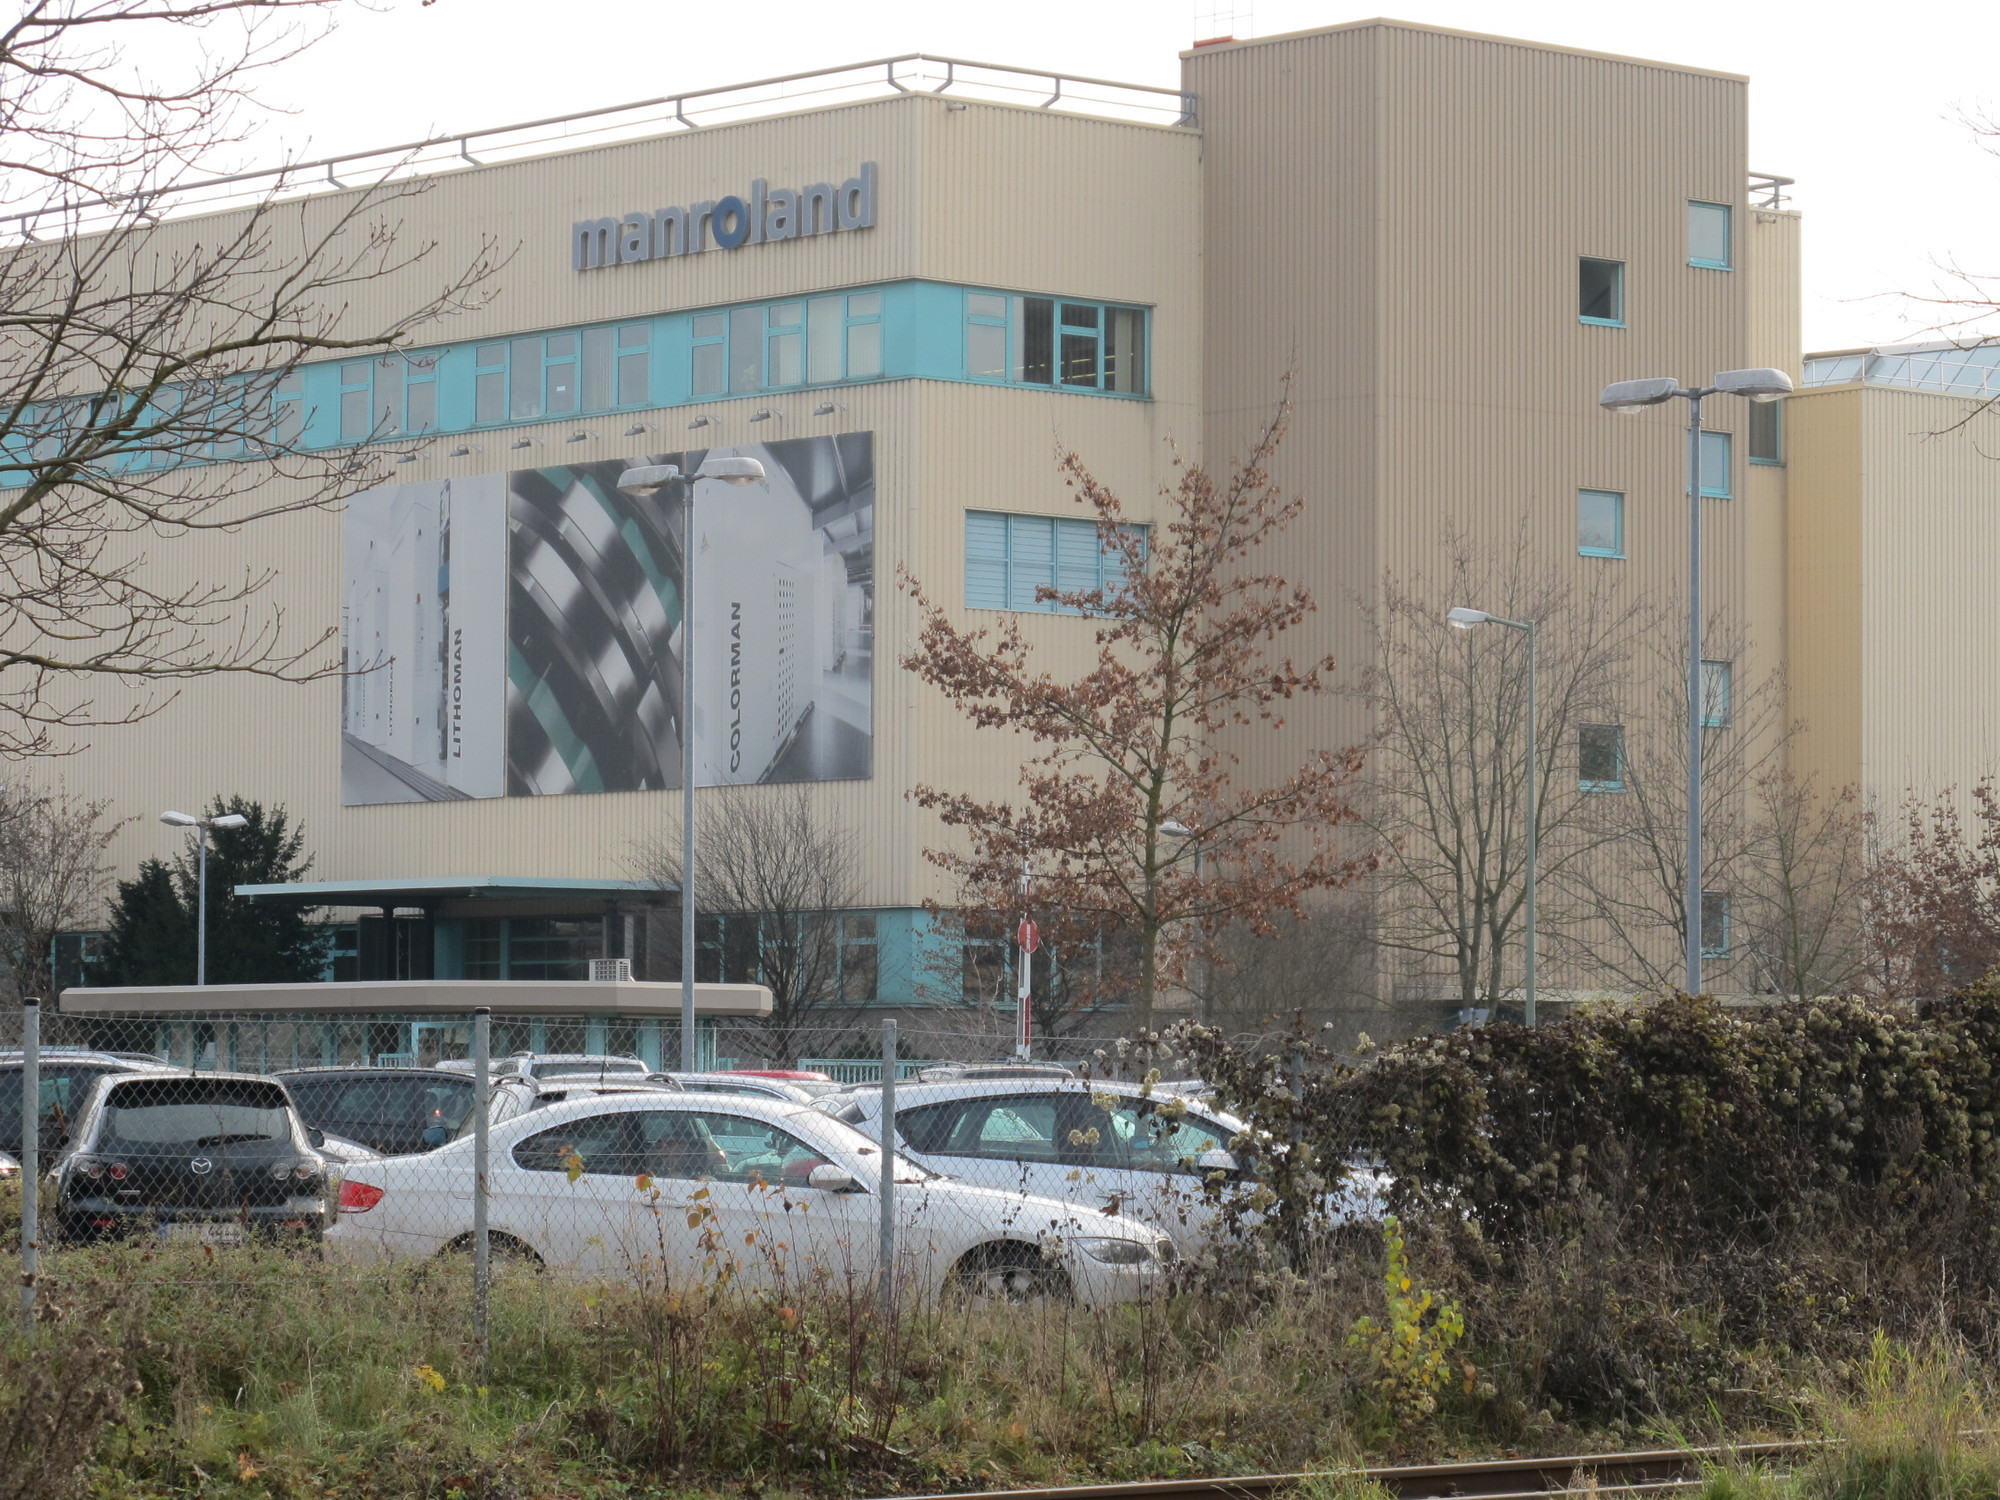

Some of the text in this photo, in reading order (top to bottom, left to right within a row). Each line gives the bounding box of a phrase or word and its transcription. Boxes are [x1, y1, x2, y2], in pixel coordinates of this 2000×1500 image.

[572, 160, 878, 270] manroland
[453, 629, 462, 758] LITHOMAN
[730, 602, 741, 773] COLORMAN
